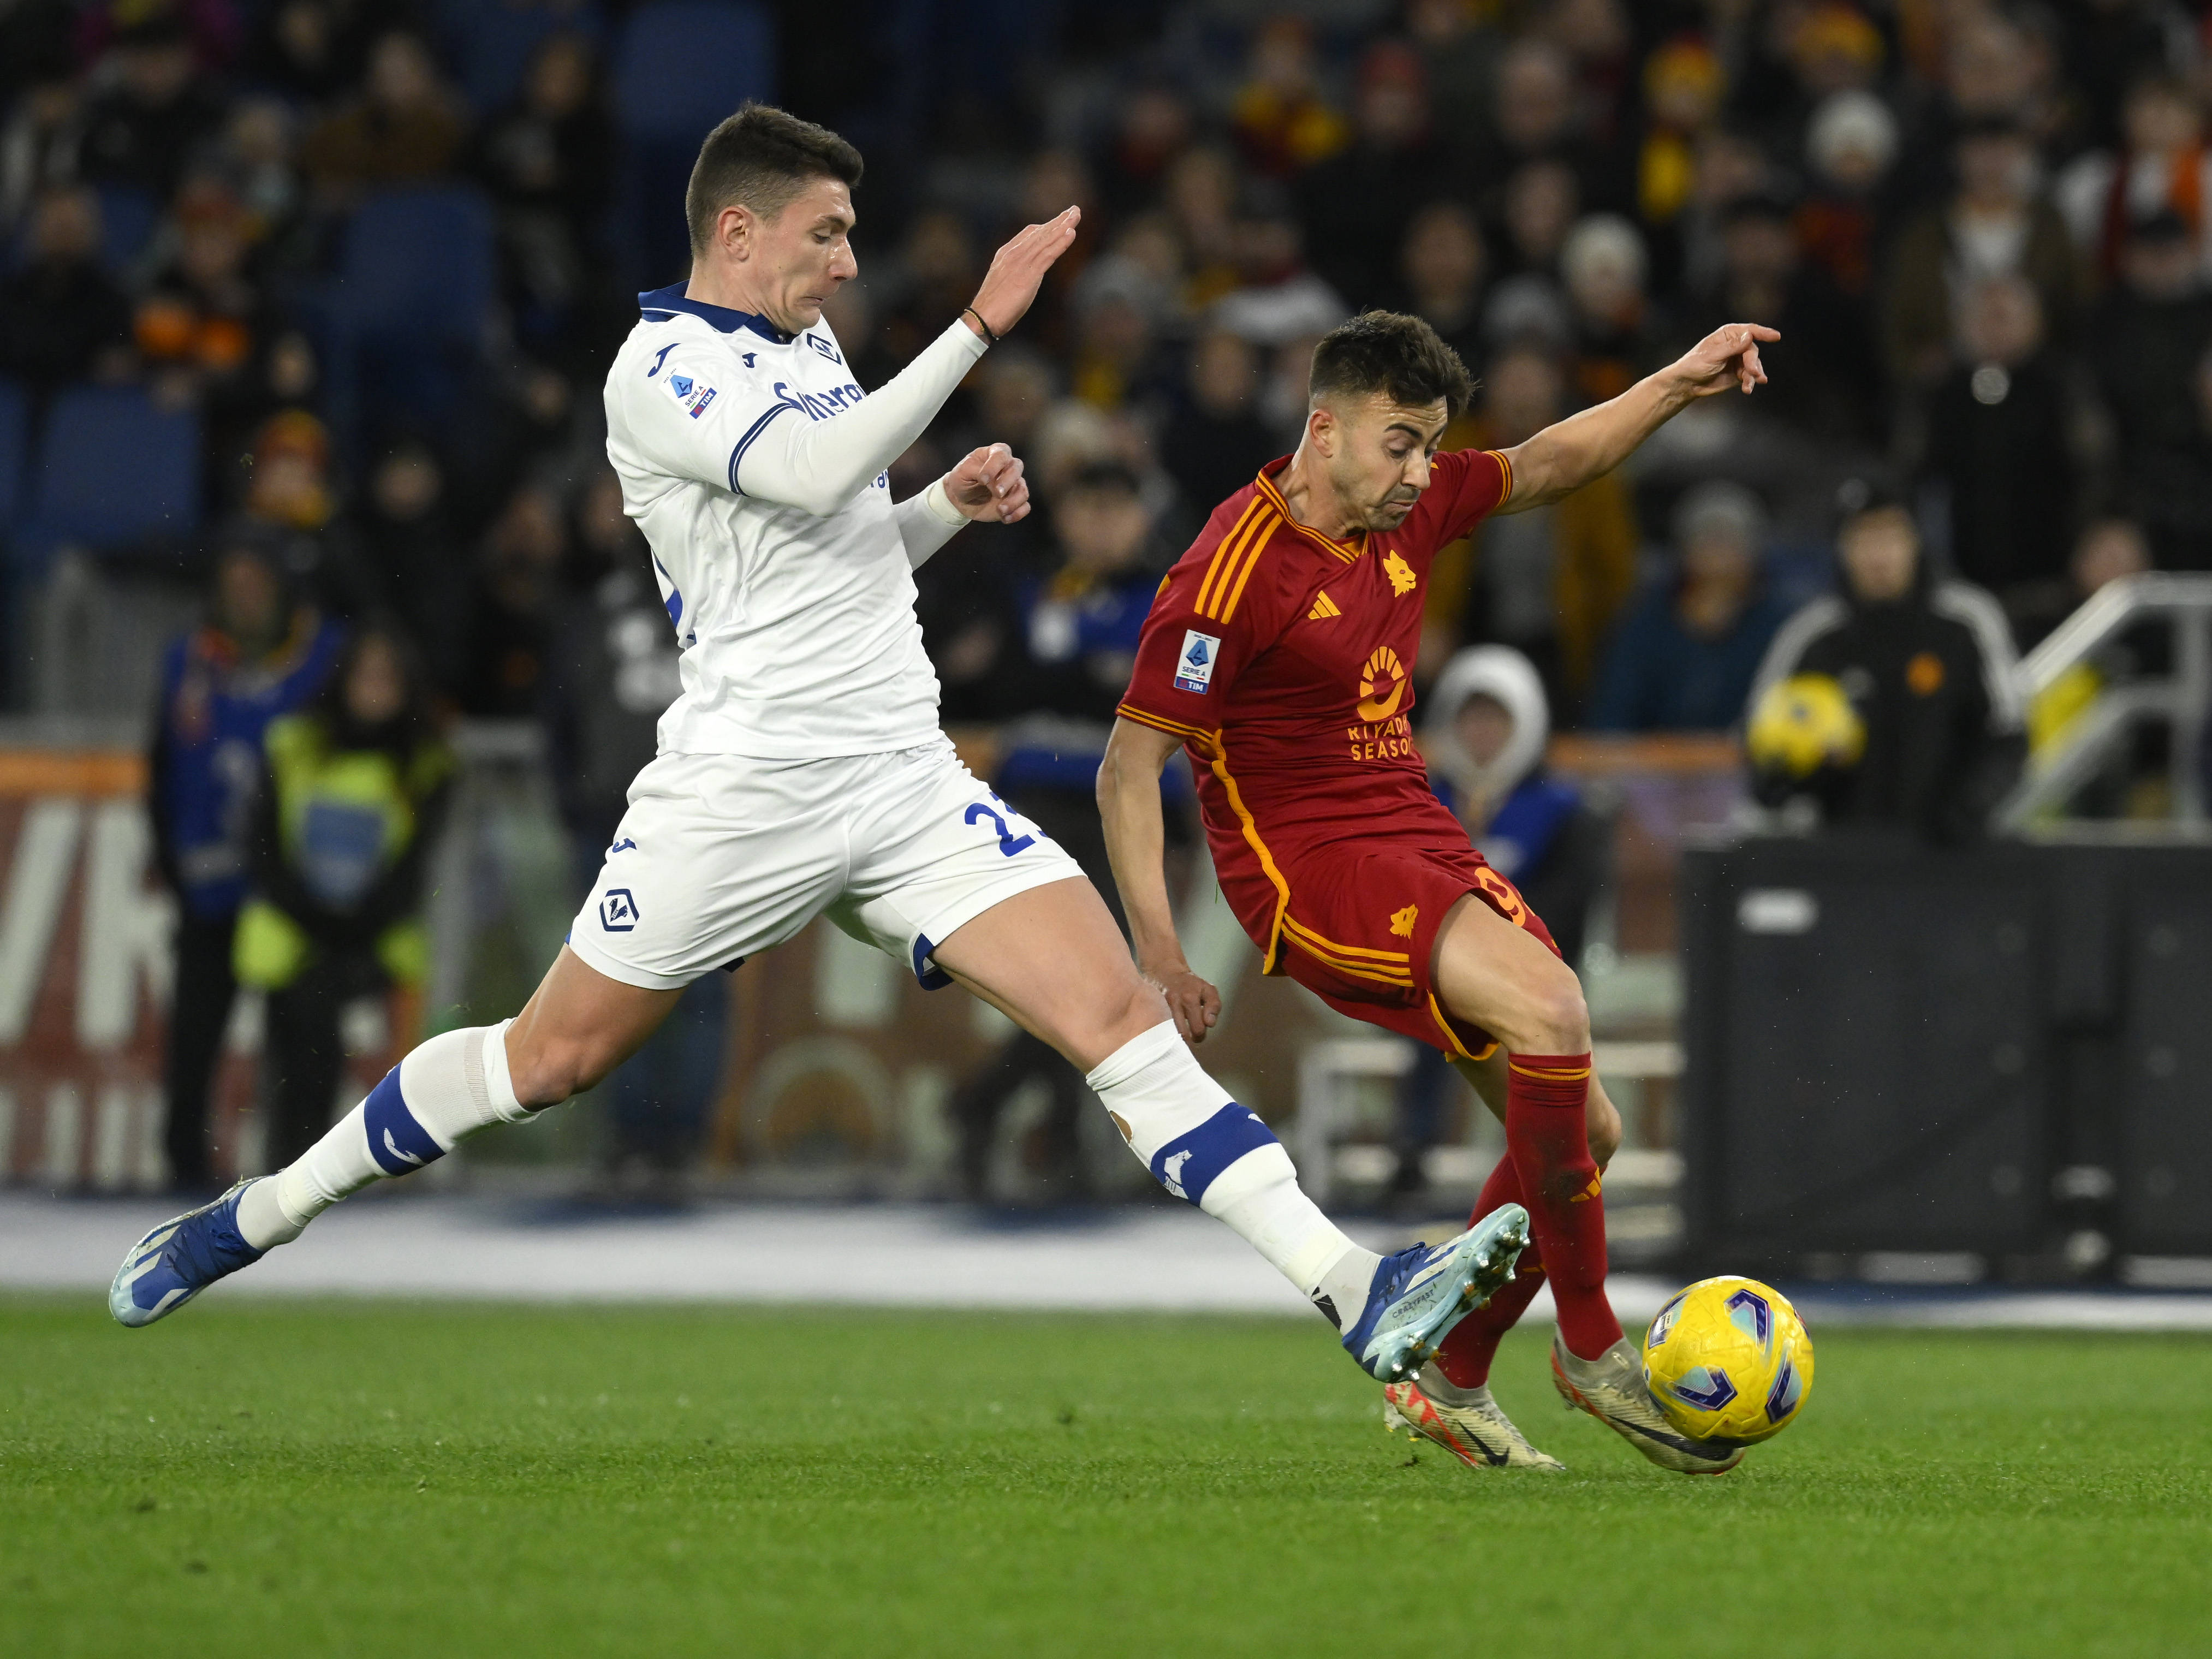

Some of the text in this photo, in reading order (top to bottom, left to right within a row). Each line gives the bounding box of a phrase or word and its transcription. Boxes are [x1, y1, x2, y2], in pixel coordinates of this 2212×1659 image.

[685, 390, 700, 407] SERIE
[700, 392, 714, 407] TIM
[1182, 666, 1200, 675] SERIE
[1188, 681, 1204, 692] TIM
[1351, 735, 1411, 761] SEASO
[964, 792, 1049, 857] 2
